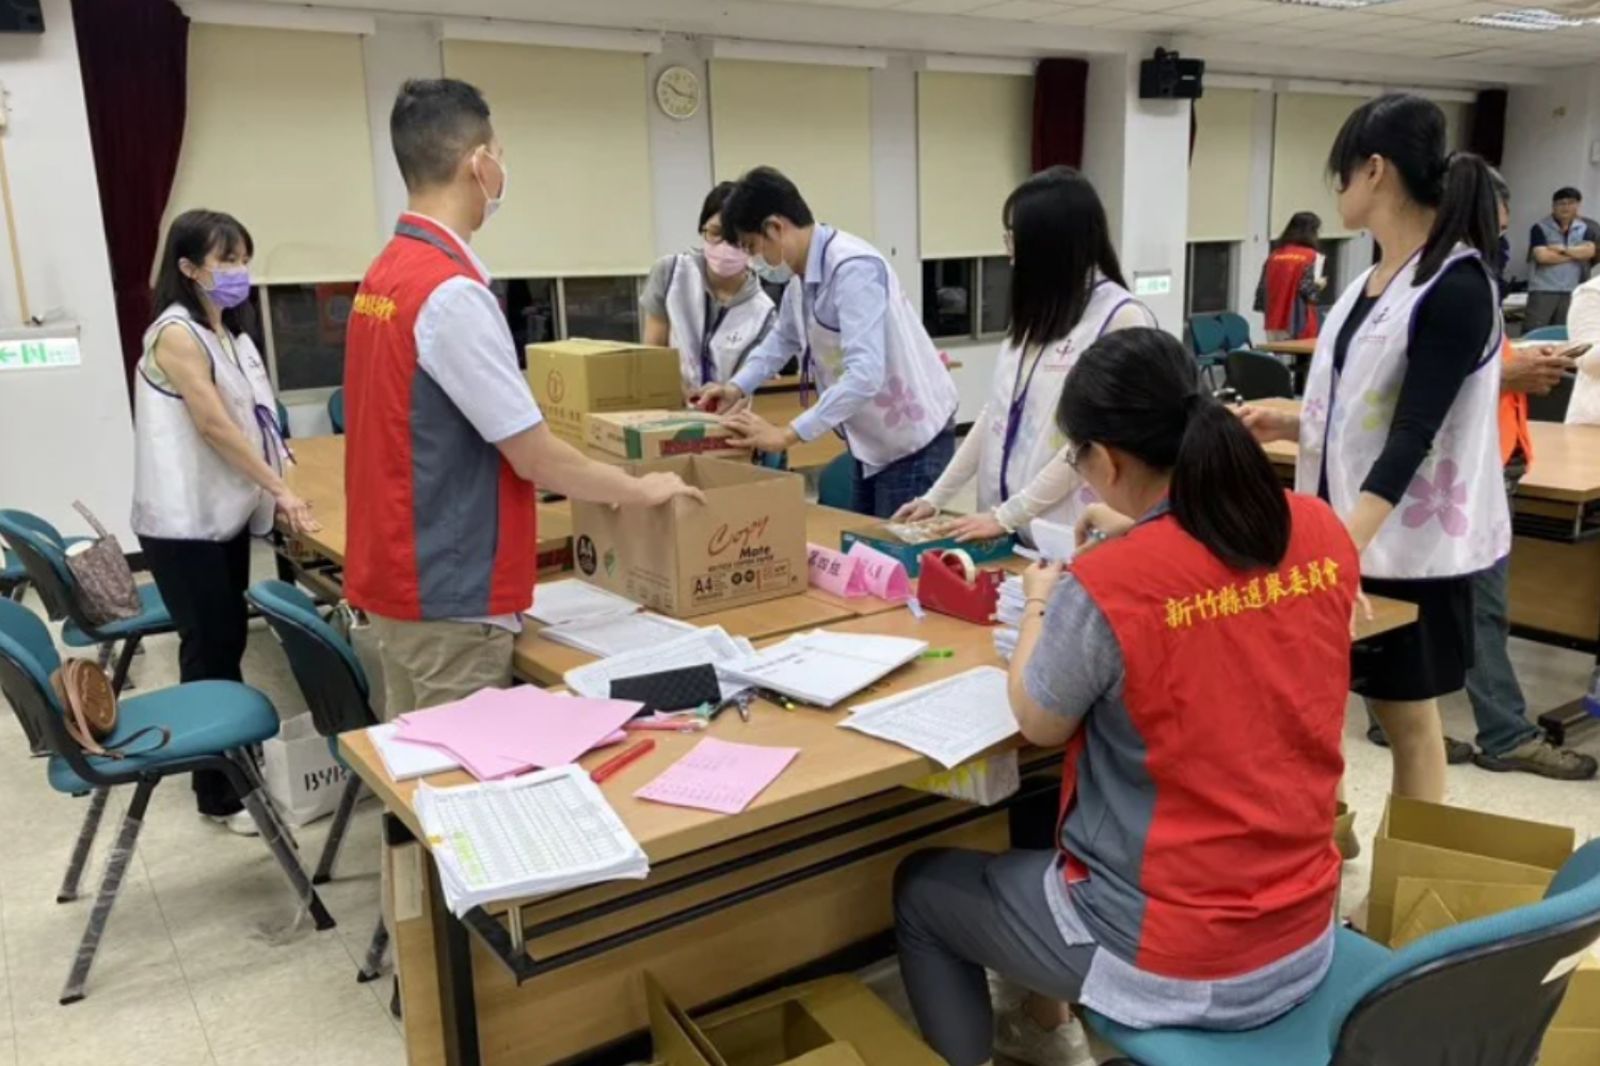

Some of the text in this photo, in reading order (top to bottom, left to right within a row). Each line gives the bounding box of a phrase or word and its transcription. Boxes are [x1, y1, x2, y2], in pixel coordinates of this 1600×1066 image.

[740, 545, 770, 559] Mate
[693, 577, 713, 595] A4
[1165, 557, 1338, 628] 新竹縣選舉委員會
